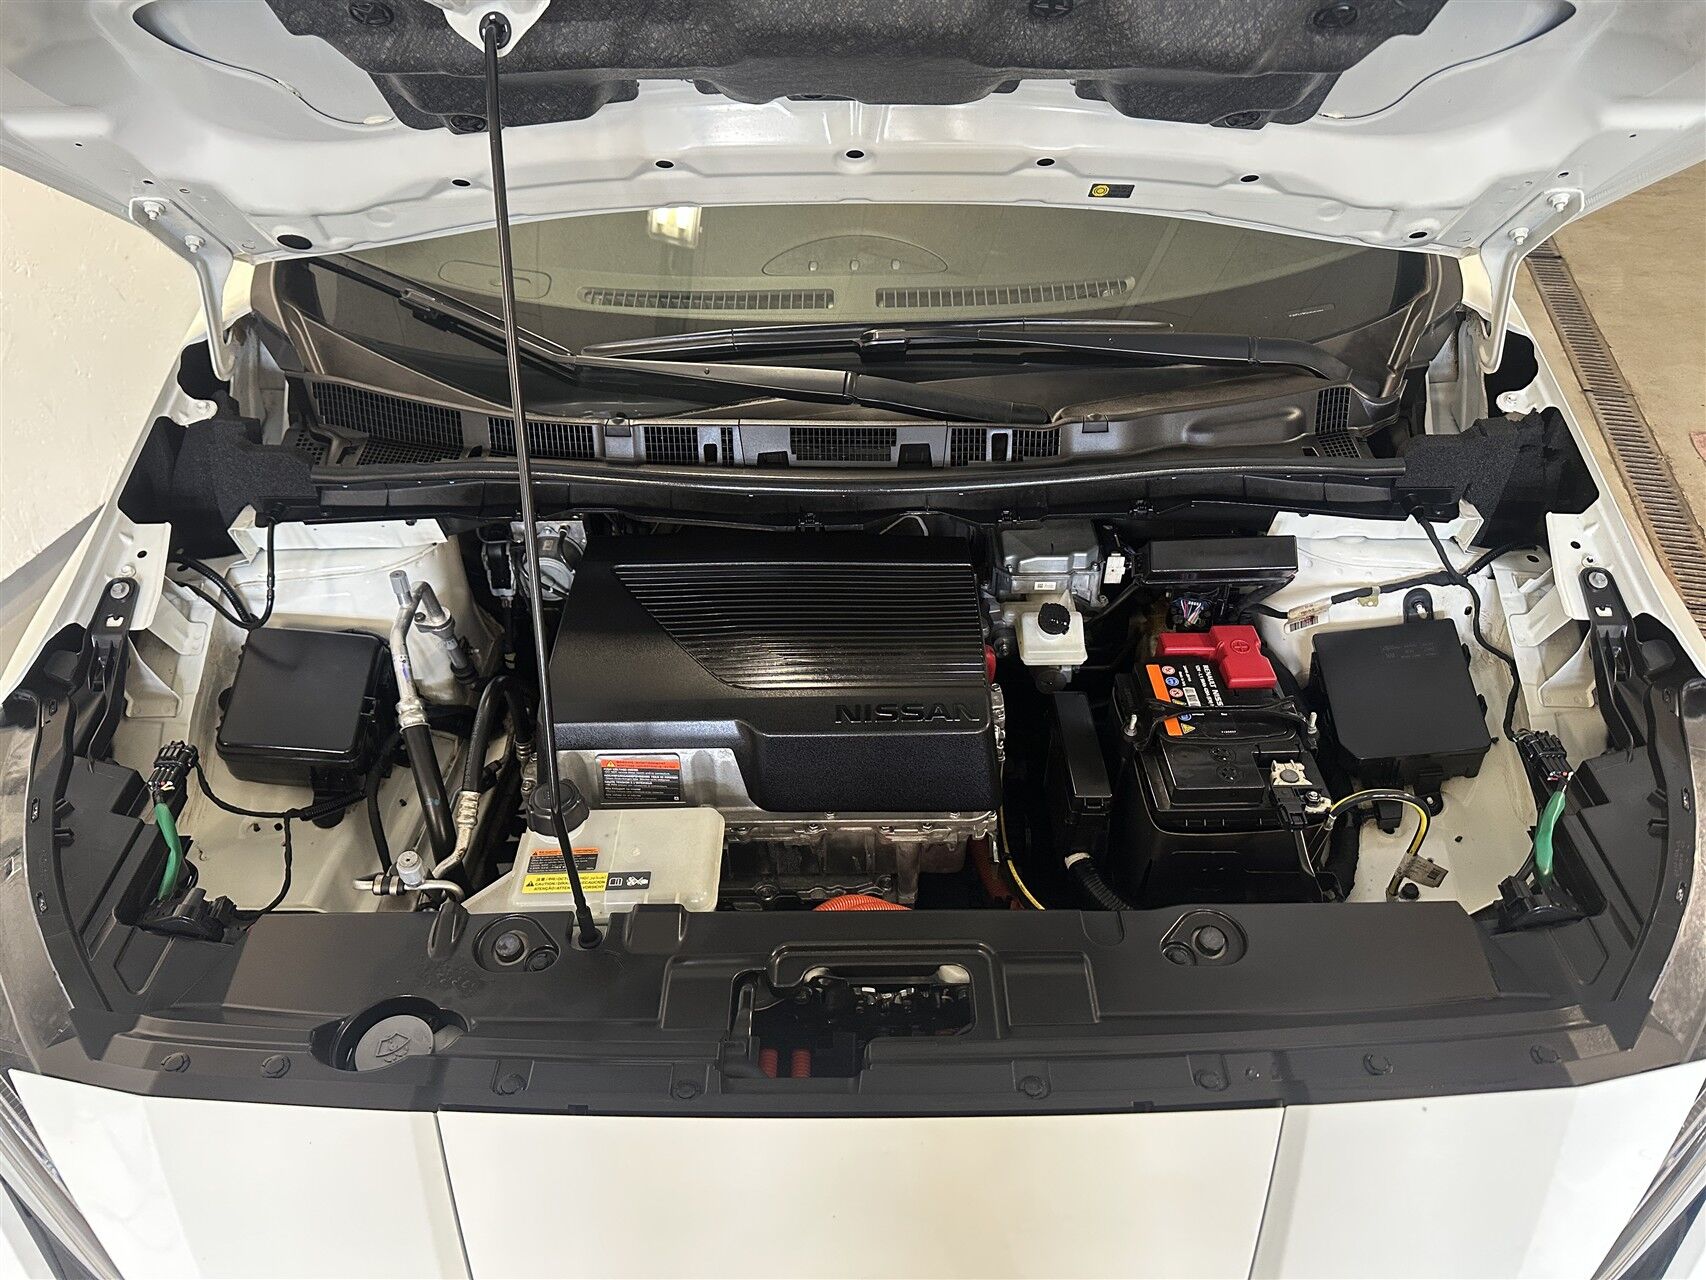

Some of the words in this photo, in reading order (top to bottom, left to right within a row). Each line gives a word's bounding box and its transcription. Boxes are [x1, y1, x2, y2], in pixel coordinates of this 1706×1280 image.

[1202, 665, 1216, 687] RENAULT
[1212, 690, 1224, 706] NISS
[835, 703, 980, 723] NISSAN
